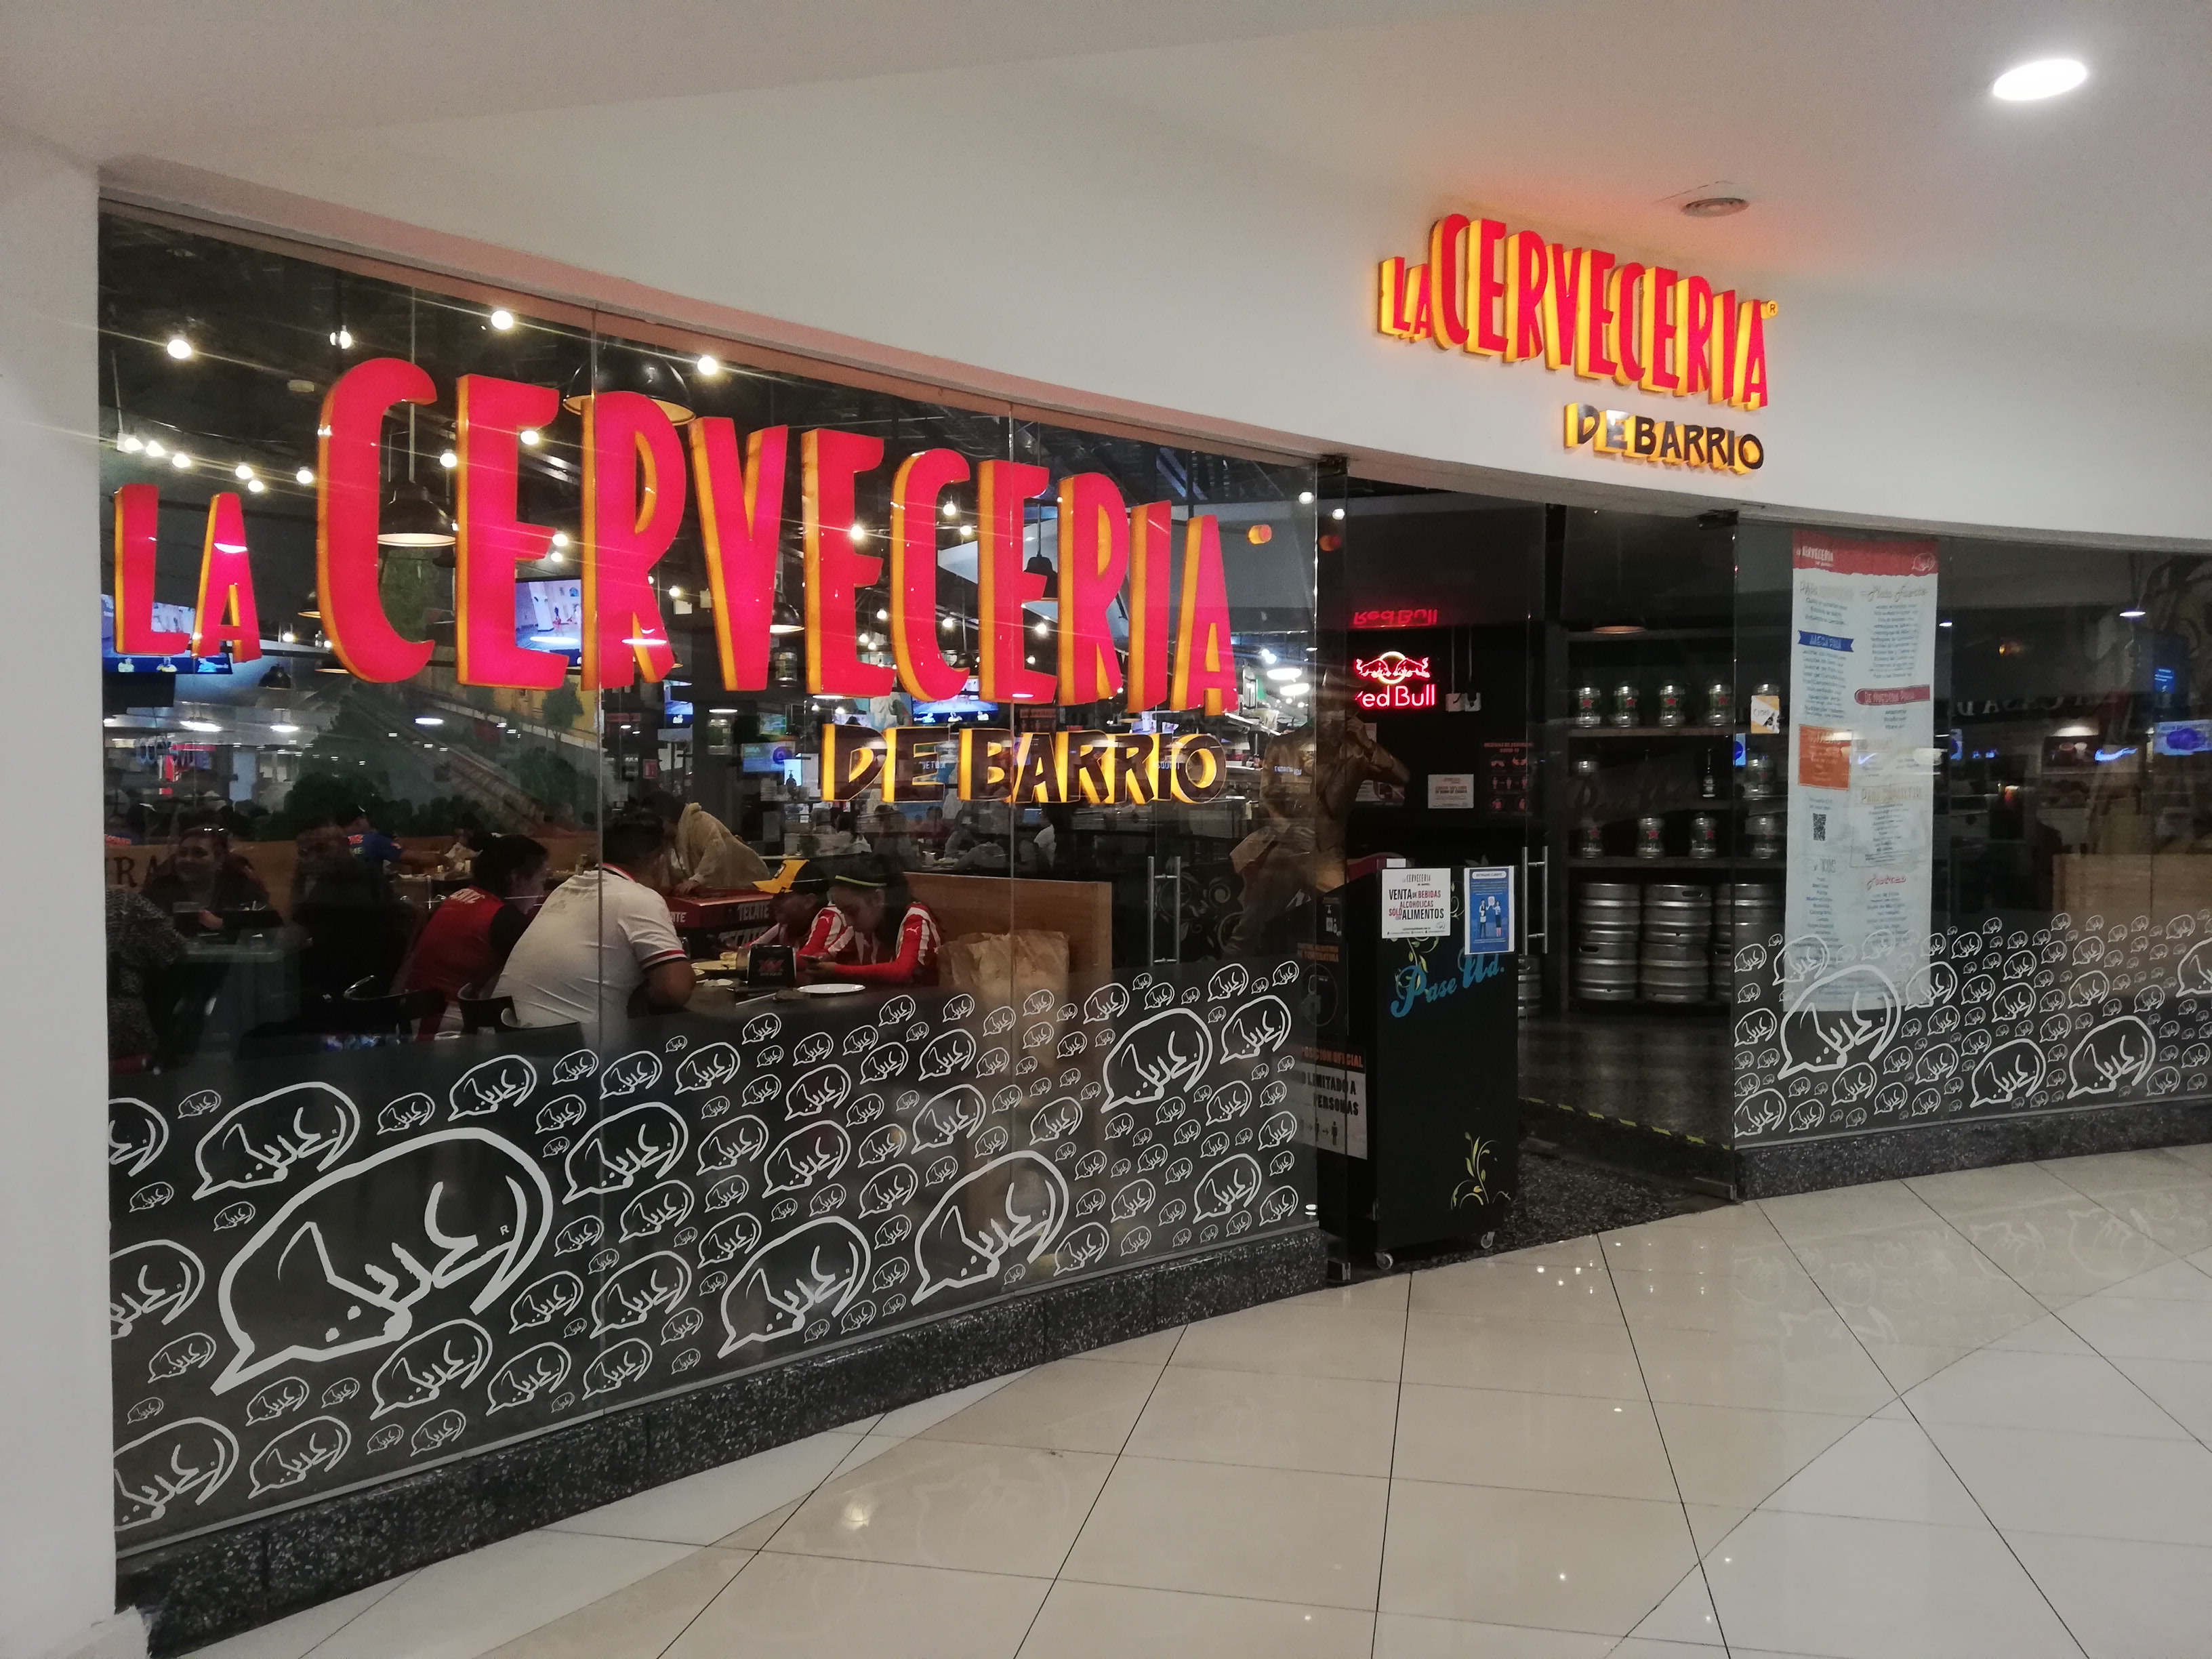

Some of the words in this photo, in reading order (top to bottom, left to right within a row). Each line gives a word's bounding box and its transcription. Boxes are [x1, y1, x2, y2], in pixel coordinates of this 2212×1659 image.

[1378, 256, 1432, 340] LA
[1429, 213, 1769, 410] CERVECERIA
[1563, 403, 1629, 453] DE
[1624, 415, 1765, 476] BARRIO
[114, 483, 263, 663] LA
[316, 357, 1239, 716] CERVECERIA
[1355, 684, 1390, 708] ed
[1395, 684, 1435, 706] Bull
[821, 723, 945, 803] DE
[958, 727, 1227, 804] BARRIO
[737, 901, 770, 922] TECATE
[1389, 888, 1412, 901] VENTA
[1418, 890, 1441, 899] BEBIDAS
[1401, 908, 1444, 920] ALIMENTOS
[1391, 965, 1457, 1018] Pase
